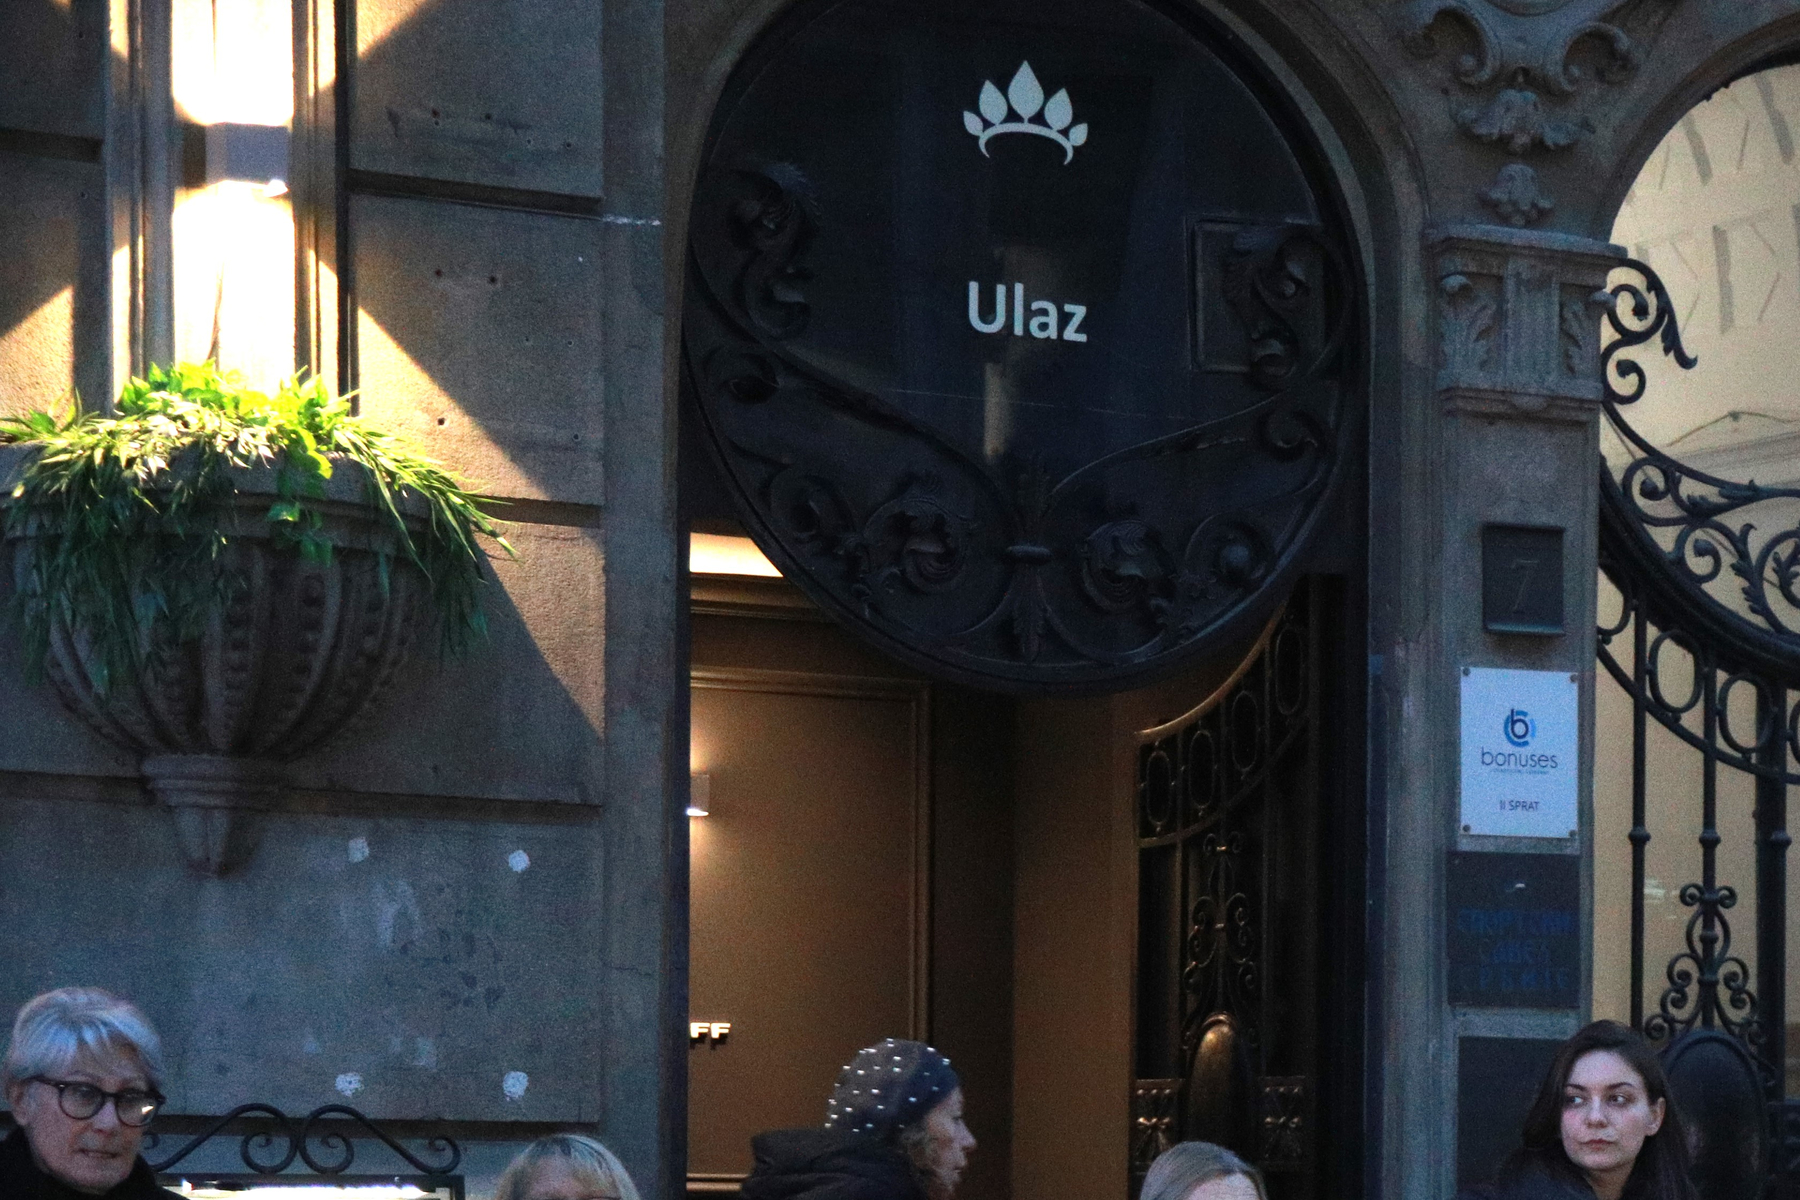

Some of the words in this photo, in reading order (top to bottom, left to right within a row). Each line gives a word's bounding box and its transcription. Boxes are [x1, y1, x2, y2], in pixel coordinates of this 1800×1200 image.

[968, 280, 1088, 342] Ulaz
[1481, 746, 1559, 769] bonuses
[1509, 801, 1540, 812] SPRAT
